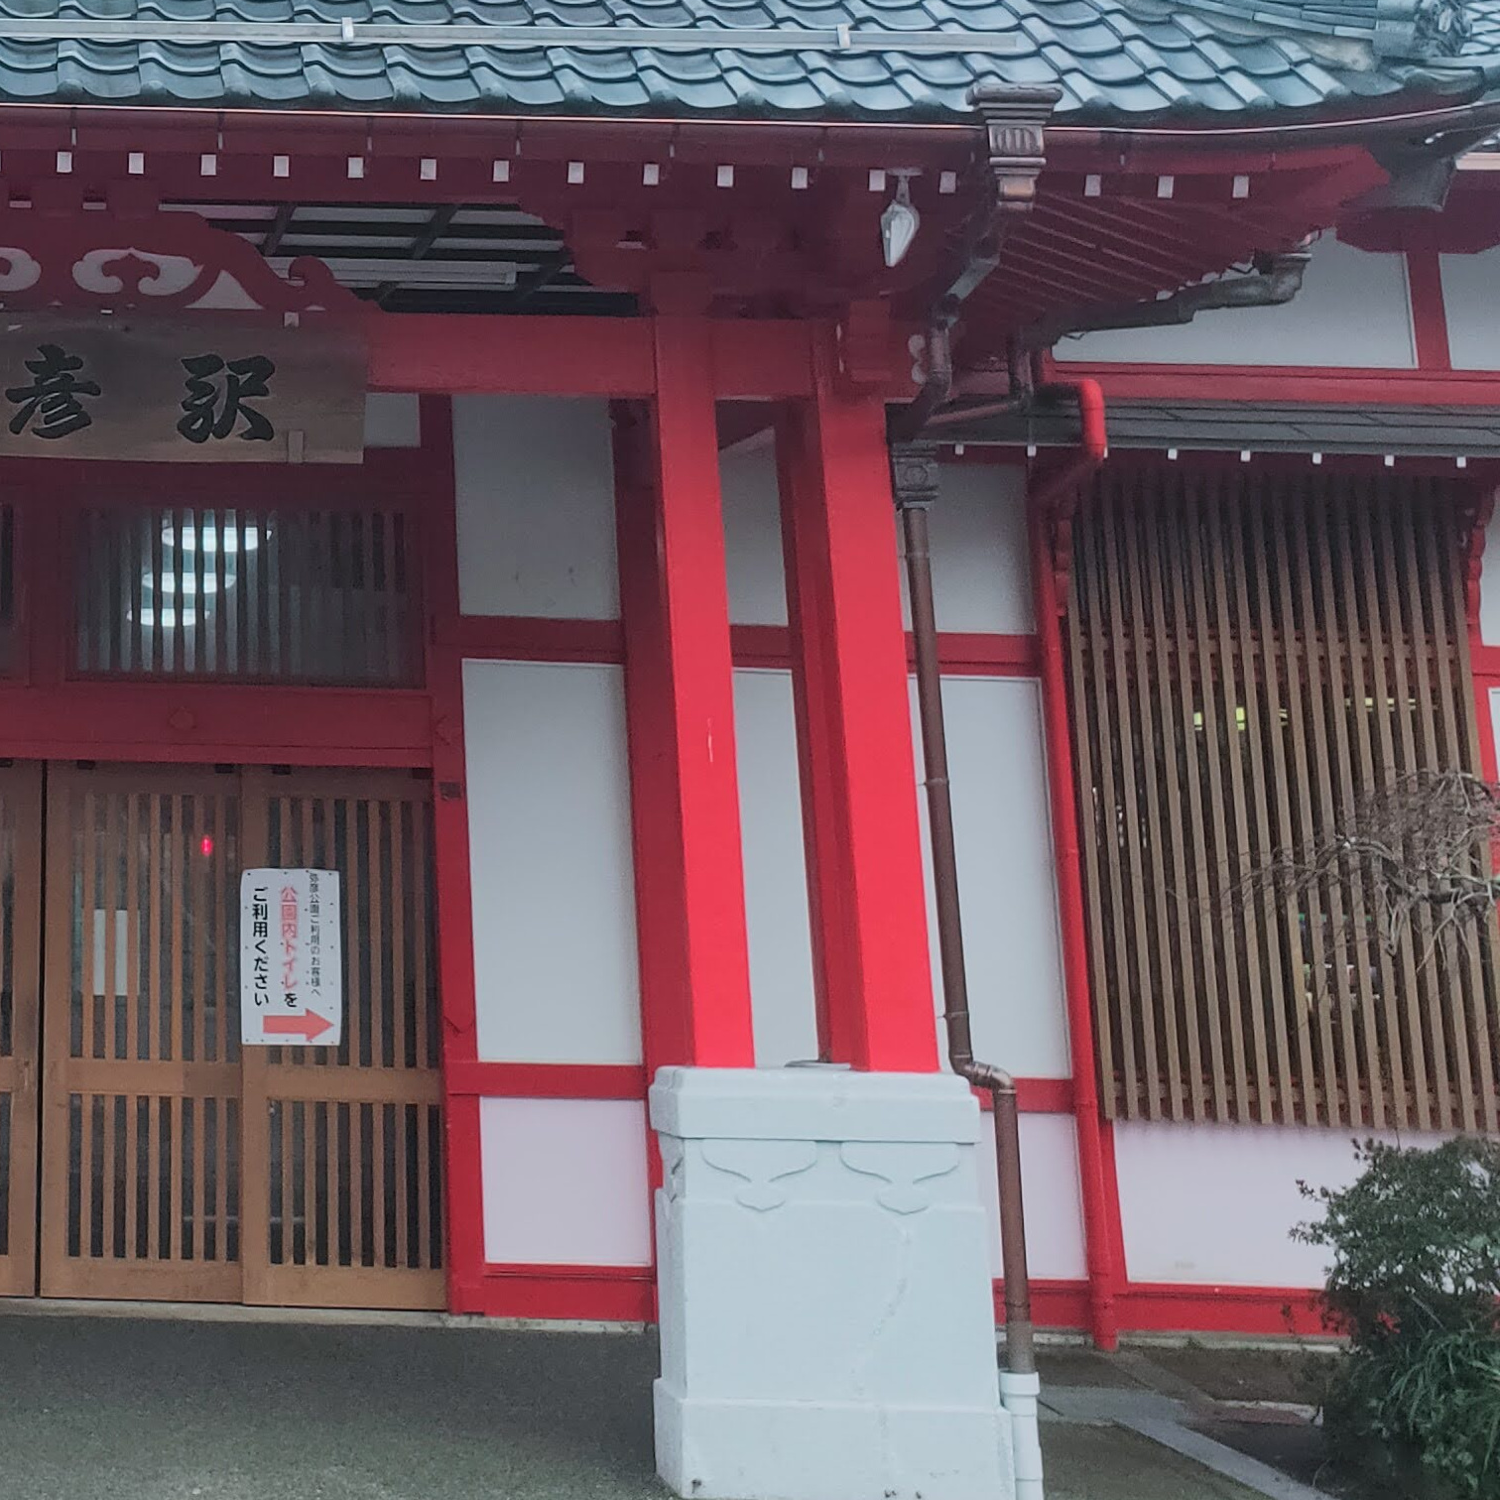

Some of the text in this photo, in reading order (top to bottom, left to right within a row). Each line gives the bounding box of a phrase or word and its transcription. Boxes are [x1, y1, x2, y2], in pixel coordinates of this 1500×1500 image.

[252, 886, 269, 1006] ご利用ください
[281, 886, 297, 1008] 公園内トイレを
